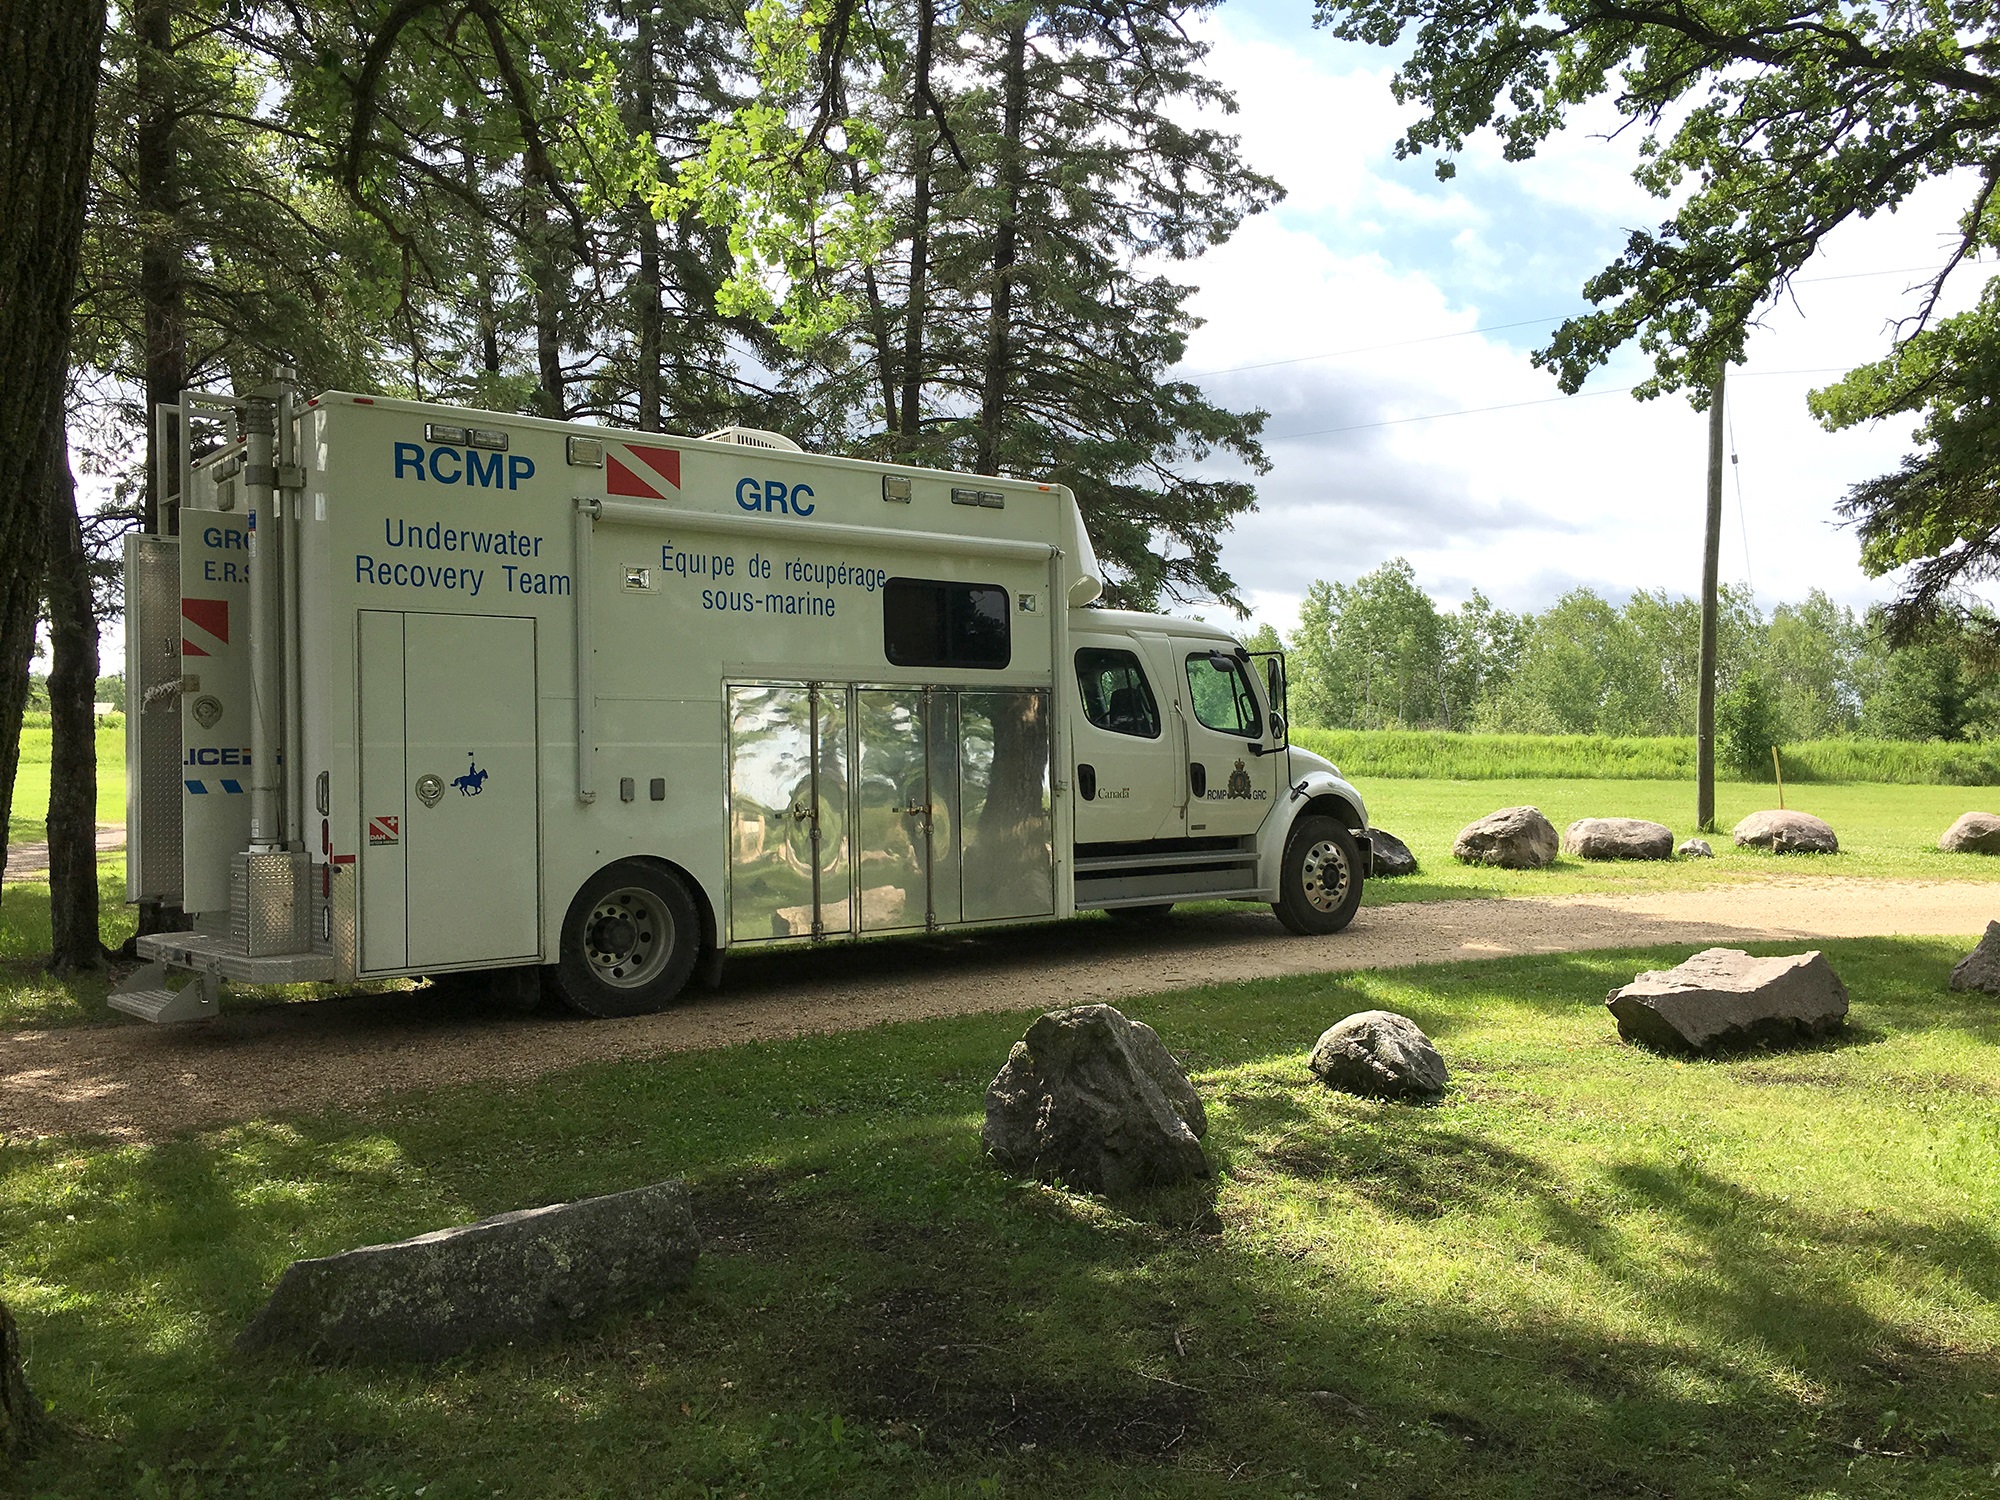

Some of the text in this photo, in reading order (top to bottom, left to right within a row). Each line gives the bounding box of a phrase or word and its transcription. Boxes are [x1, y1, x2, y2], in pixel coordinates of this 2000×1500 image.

[394, 441, 536, 491] RCMP
[735, 477, 815, 517] GRC
[385, 517, 543, 557] Underwater
[355, 554, 571, 596] Recovery Team
[661, 539, 886, 592] Équipe de récupérage
[702, 589, 836, 617] sous-marine
[183, 748, 240, 766] ICE
[1098, 787, 1130, 799] Canada
[1207, 789, 1227, 800] RCMP
[1252, 790, 1267, 800] GRC
